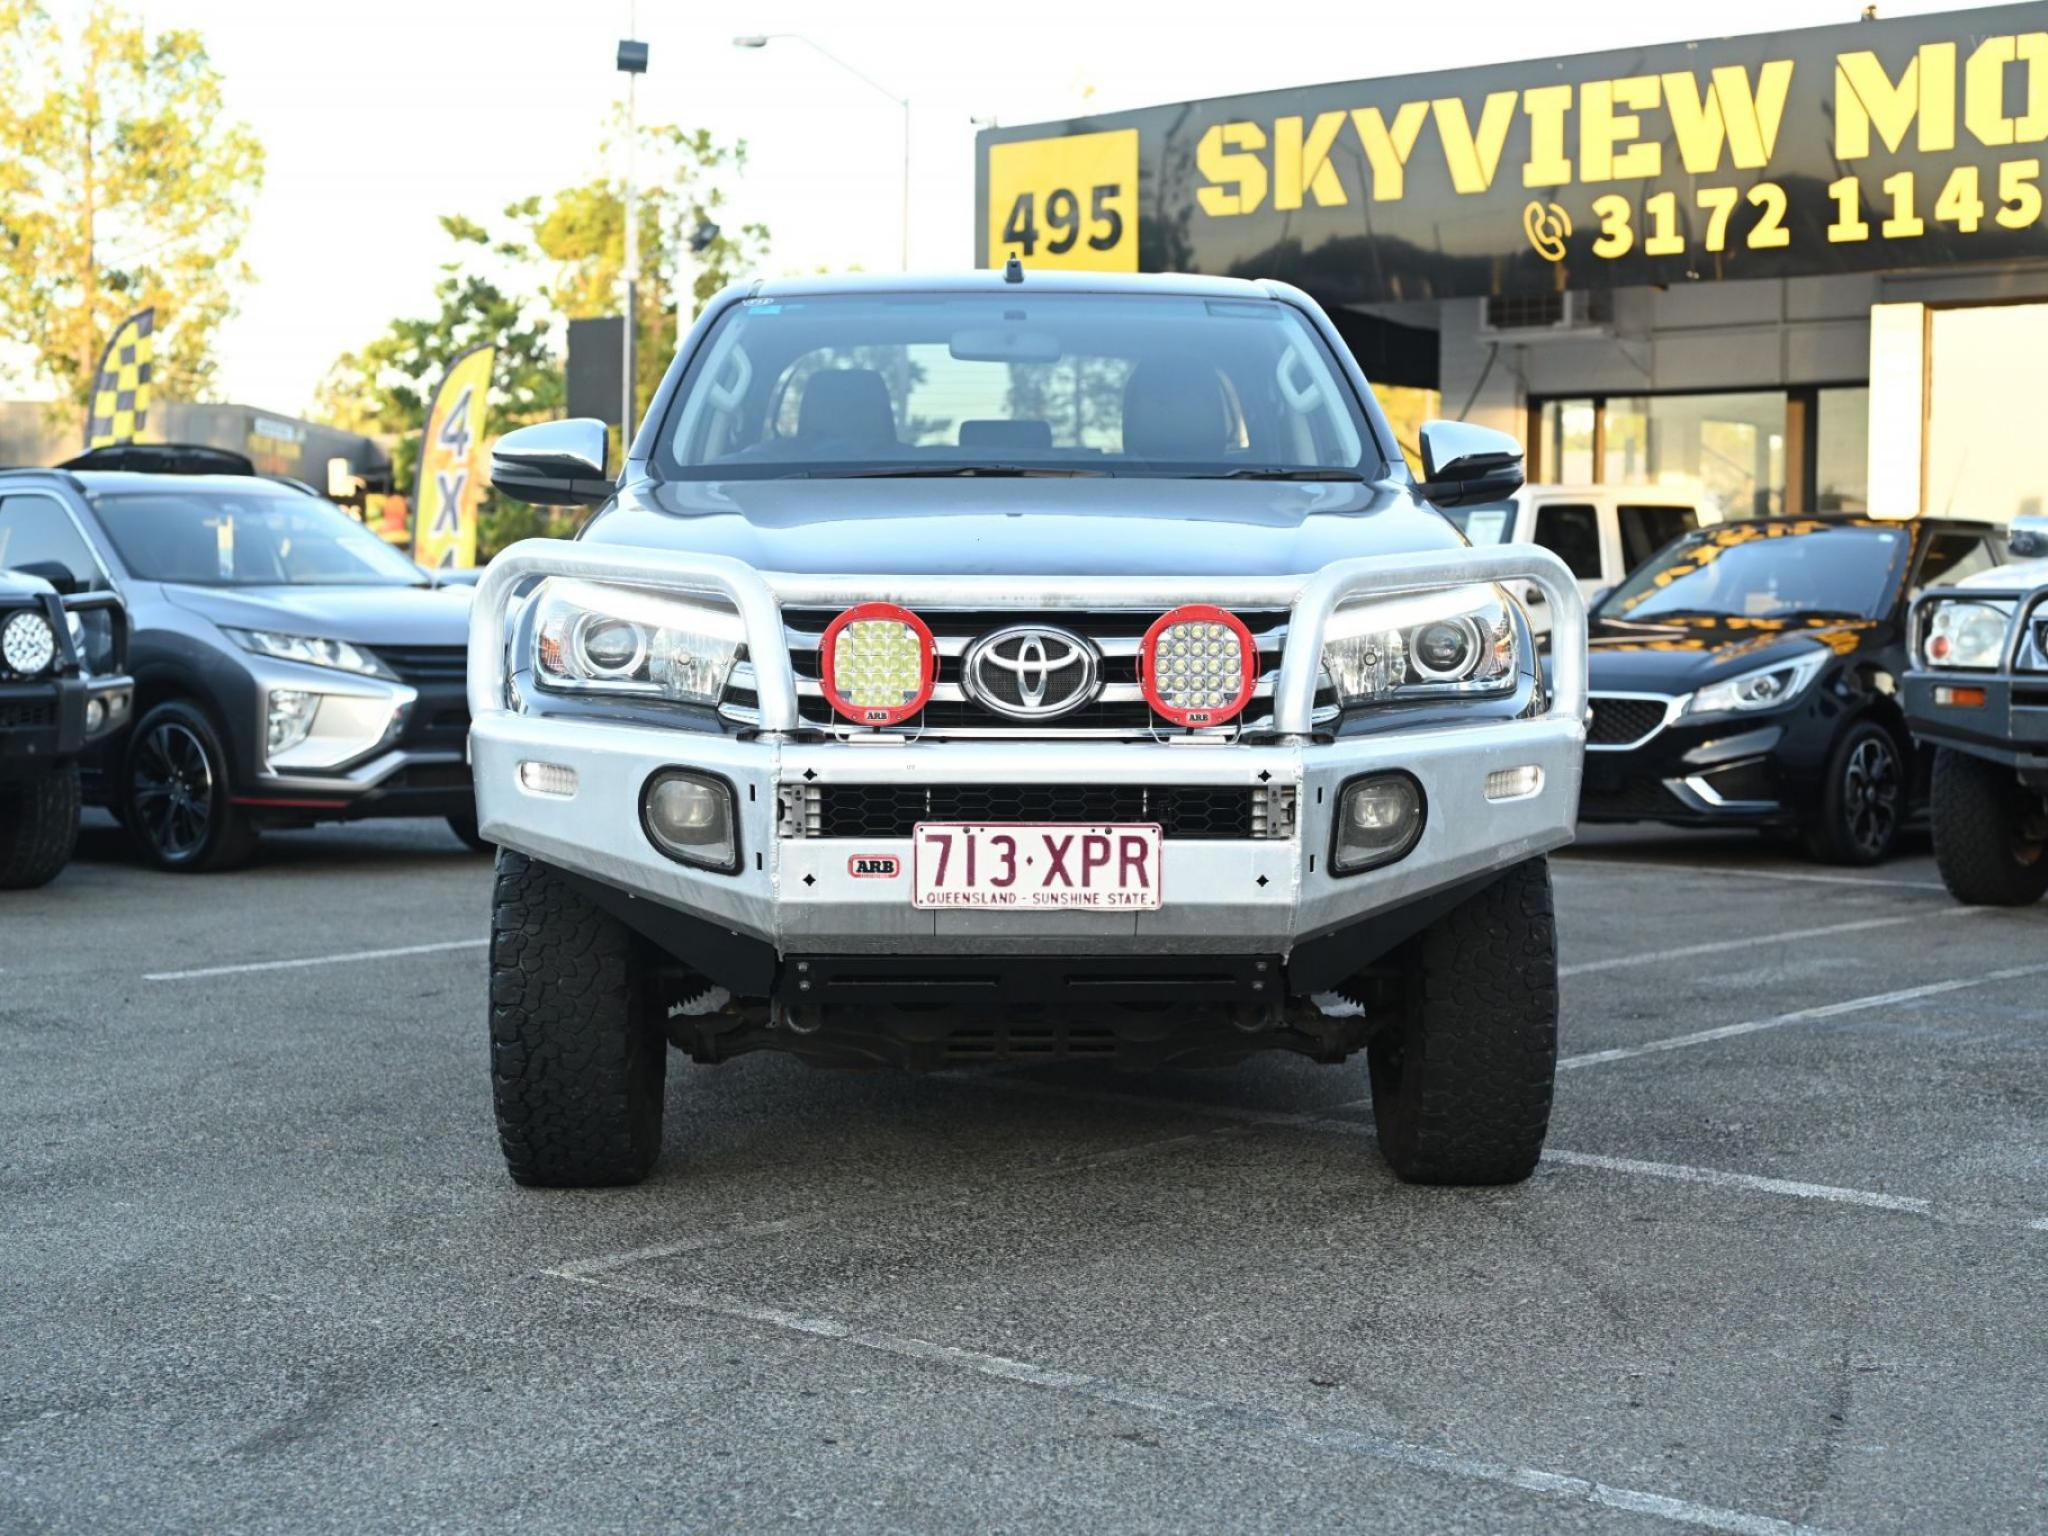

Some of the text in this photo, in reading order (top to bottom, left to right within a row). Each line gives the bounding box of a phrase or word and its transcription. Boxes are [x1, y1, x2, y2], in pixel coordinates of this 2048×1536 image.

[1196, 31, 2048, 217] SKYVIEW MO
[1002, 183, 1123, 257] 495
[1591, 159, 2042, 259] 3172 1145
[867, 711, 887, 719] ARB
[856, 860, 894, 873] ARB
[926, 892, 1017, 905] QUEENSLAND
[1032, 892, 1100, 905] SUNSHINE
[1107, 892, 1148, 905] STATE
